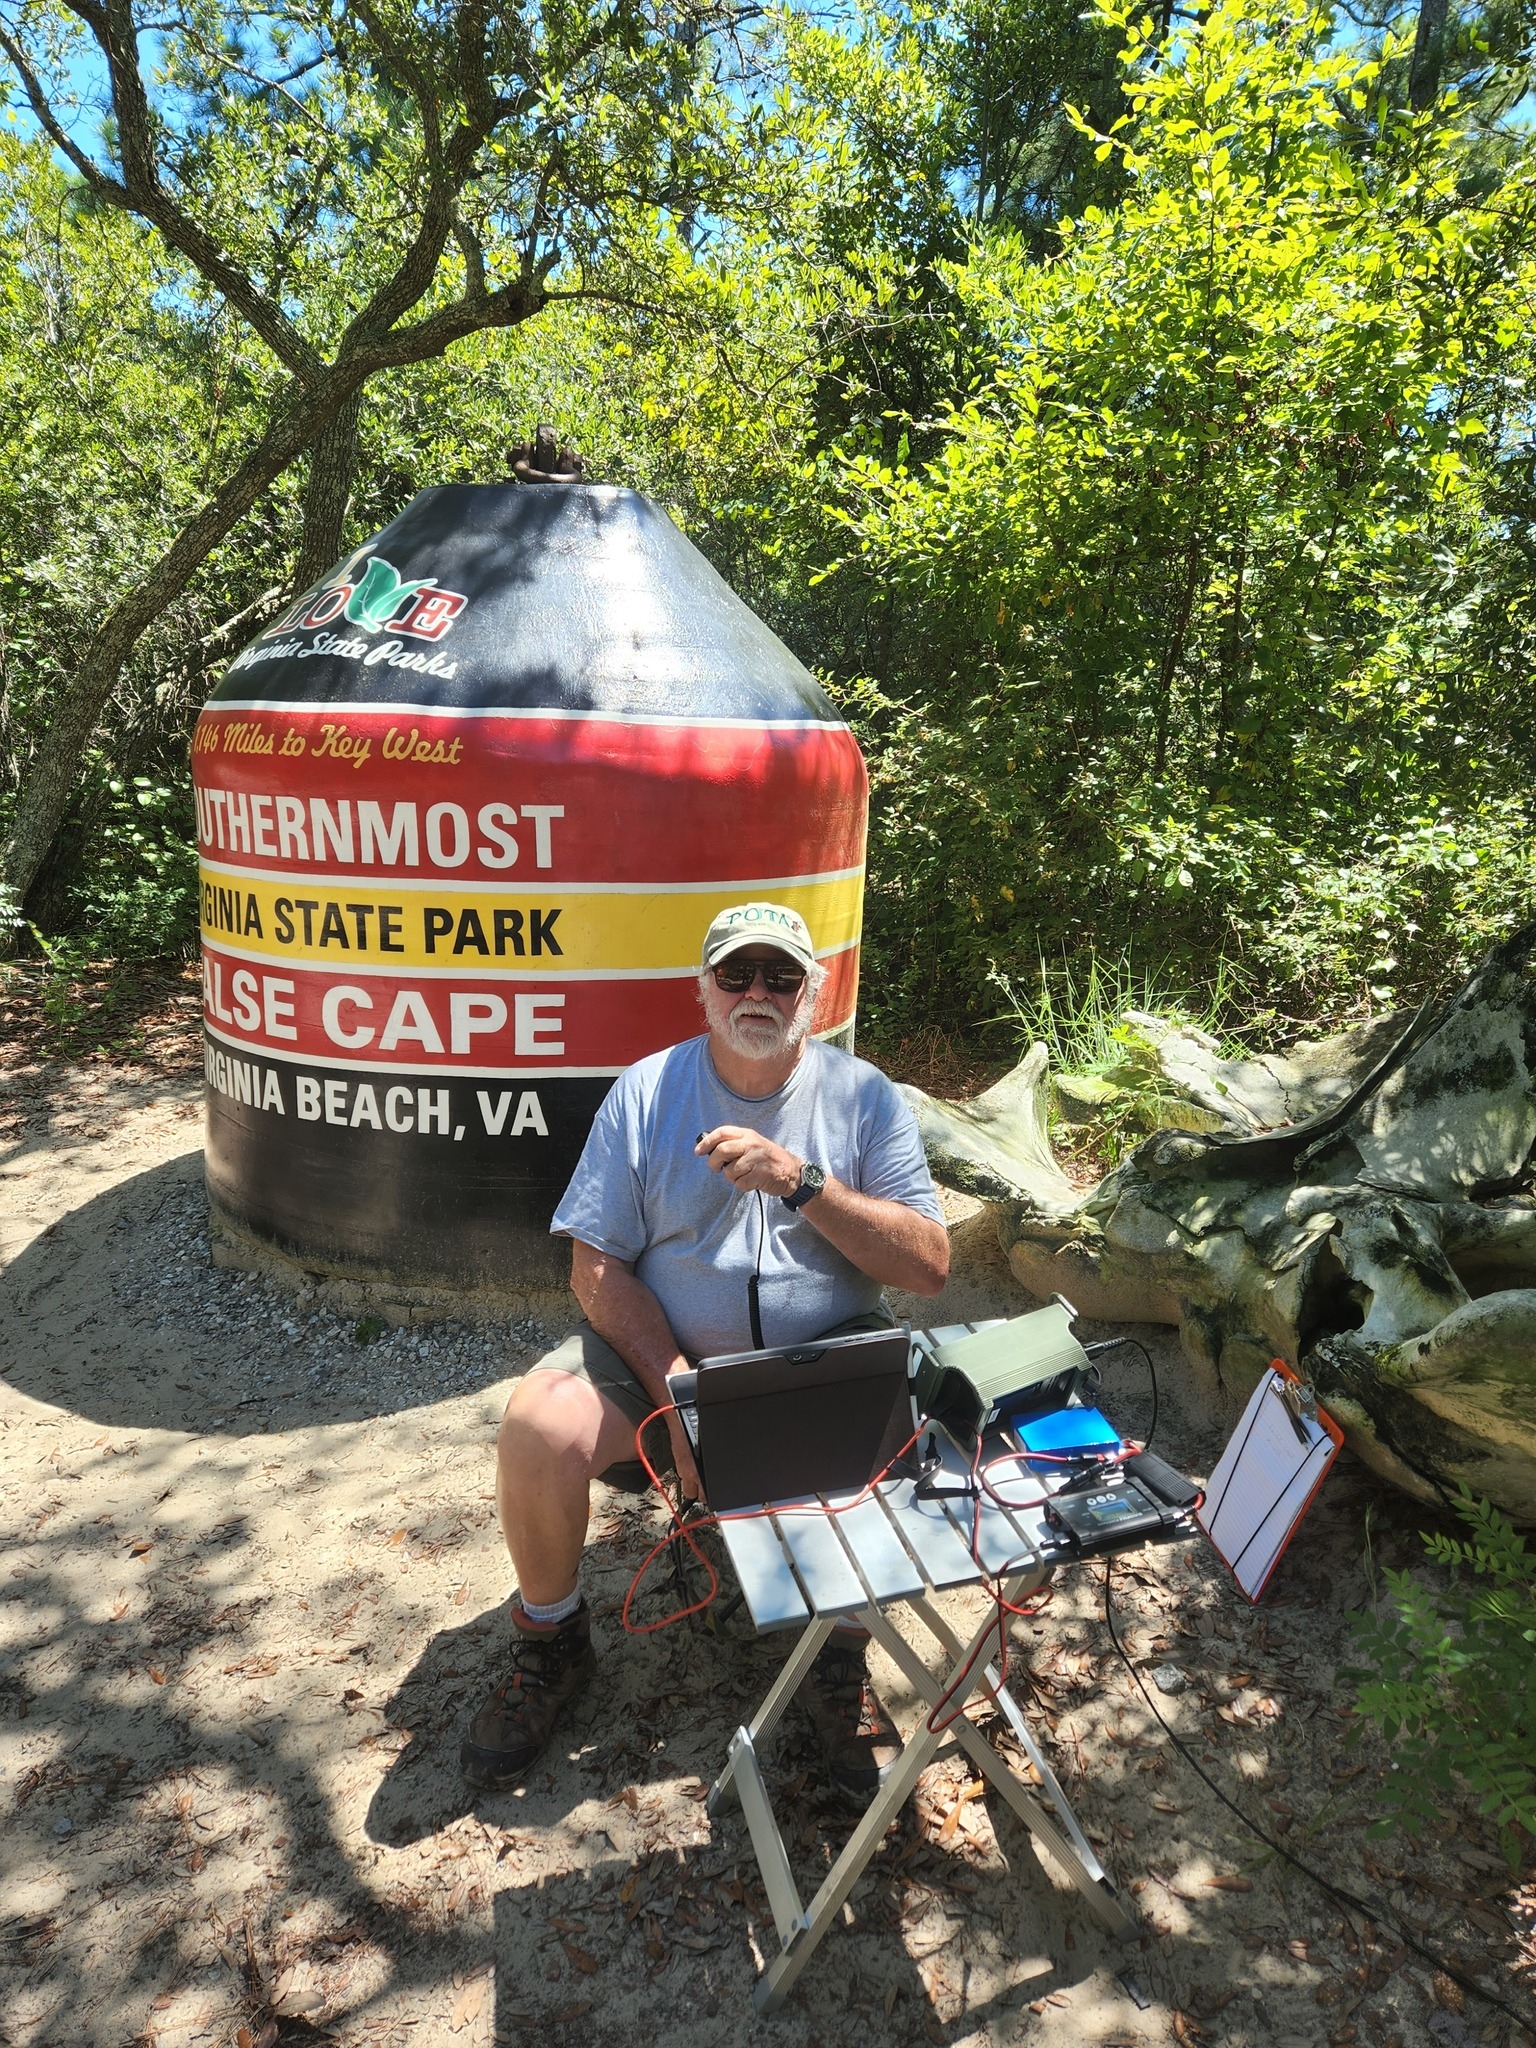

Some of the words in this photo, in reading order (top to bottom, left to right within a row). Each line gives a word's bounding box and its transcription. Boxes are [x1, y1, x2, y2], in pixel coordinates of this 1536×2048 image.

[298, 632, 368, 657] State
[363, 640, 458, 679] Parks
[223, 722, 274, 755] Miles
[278, 727, 306, 757] to
[311, 725, 371, 768] Key
[383, 727, 464, 764] West
[274, 897, 404, 952] STATE
[423, 908, 564, 956] PARK
[727, 907, 789, 928] POTA
[322, 985, 565, 1055] CAPE
[296, 1075, 465, 1141] BEACH,
[476, 1090, 549, 1136] VA
